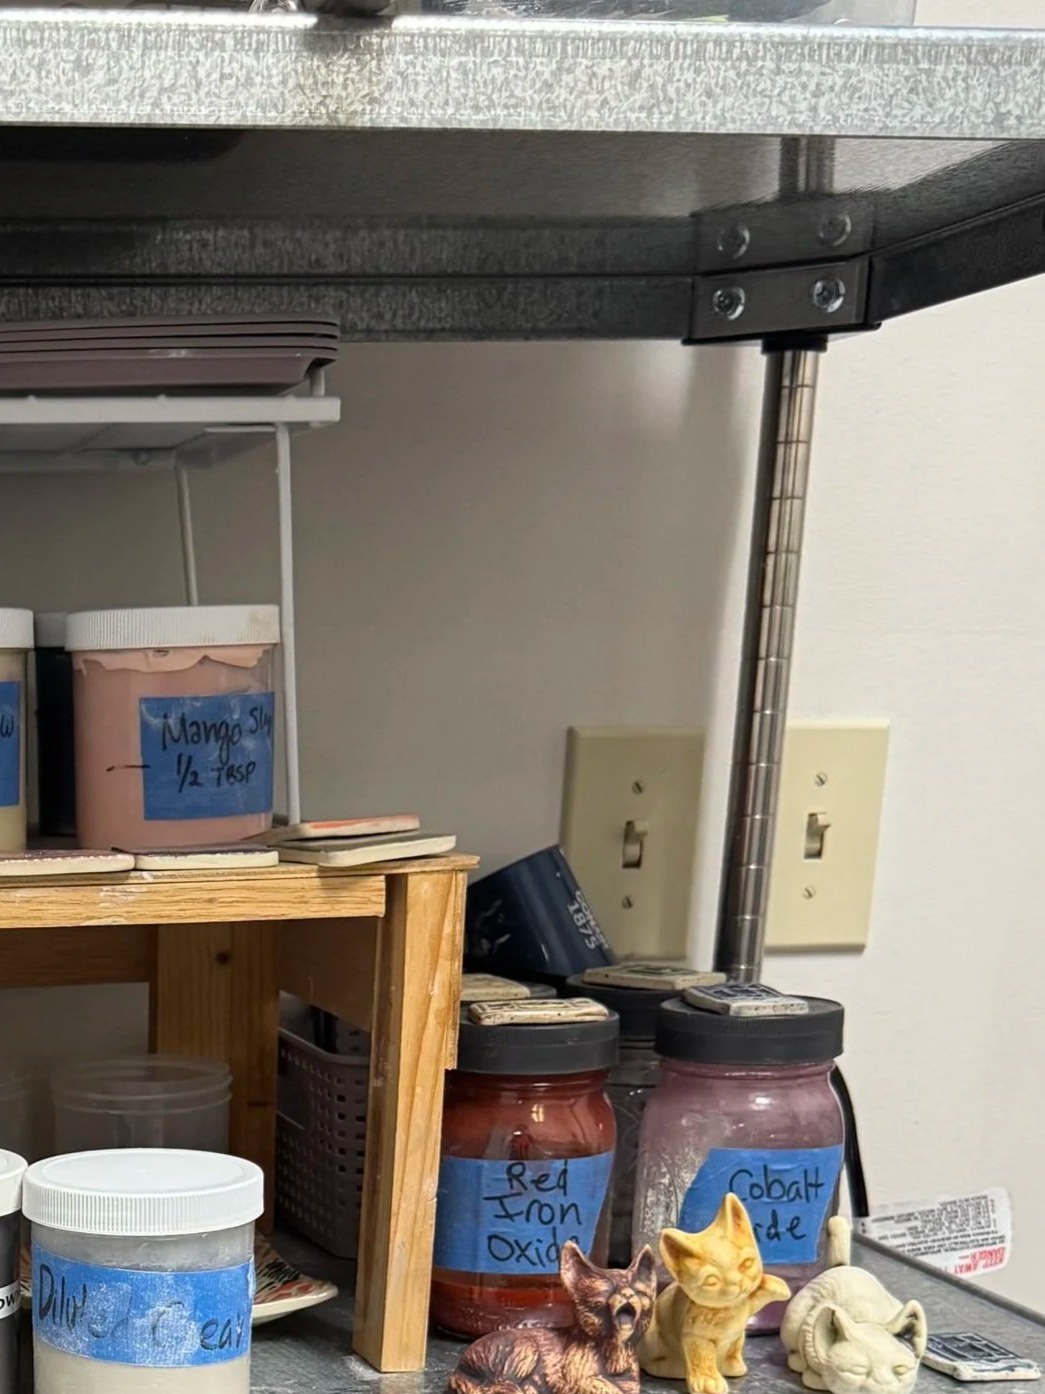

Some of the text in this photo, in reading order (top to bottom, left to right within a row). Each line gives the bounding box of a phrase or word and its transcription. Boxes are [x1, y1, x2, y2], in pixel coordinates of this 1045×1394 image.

[162, 712, 243, 767] Mango
[211, 761, 257, 787] TBSP
[567, 900, 596, 950] 1875
[506, 1159, 569, 1194] Red
[728, 1165, 825, 1204] Cobalt
[484, 1192, 584, 1227] Iron
